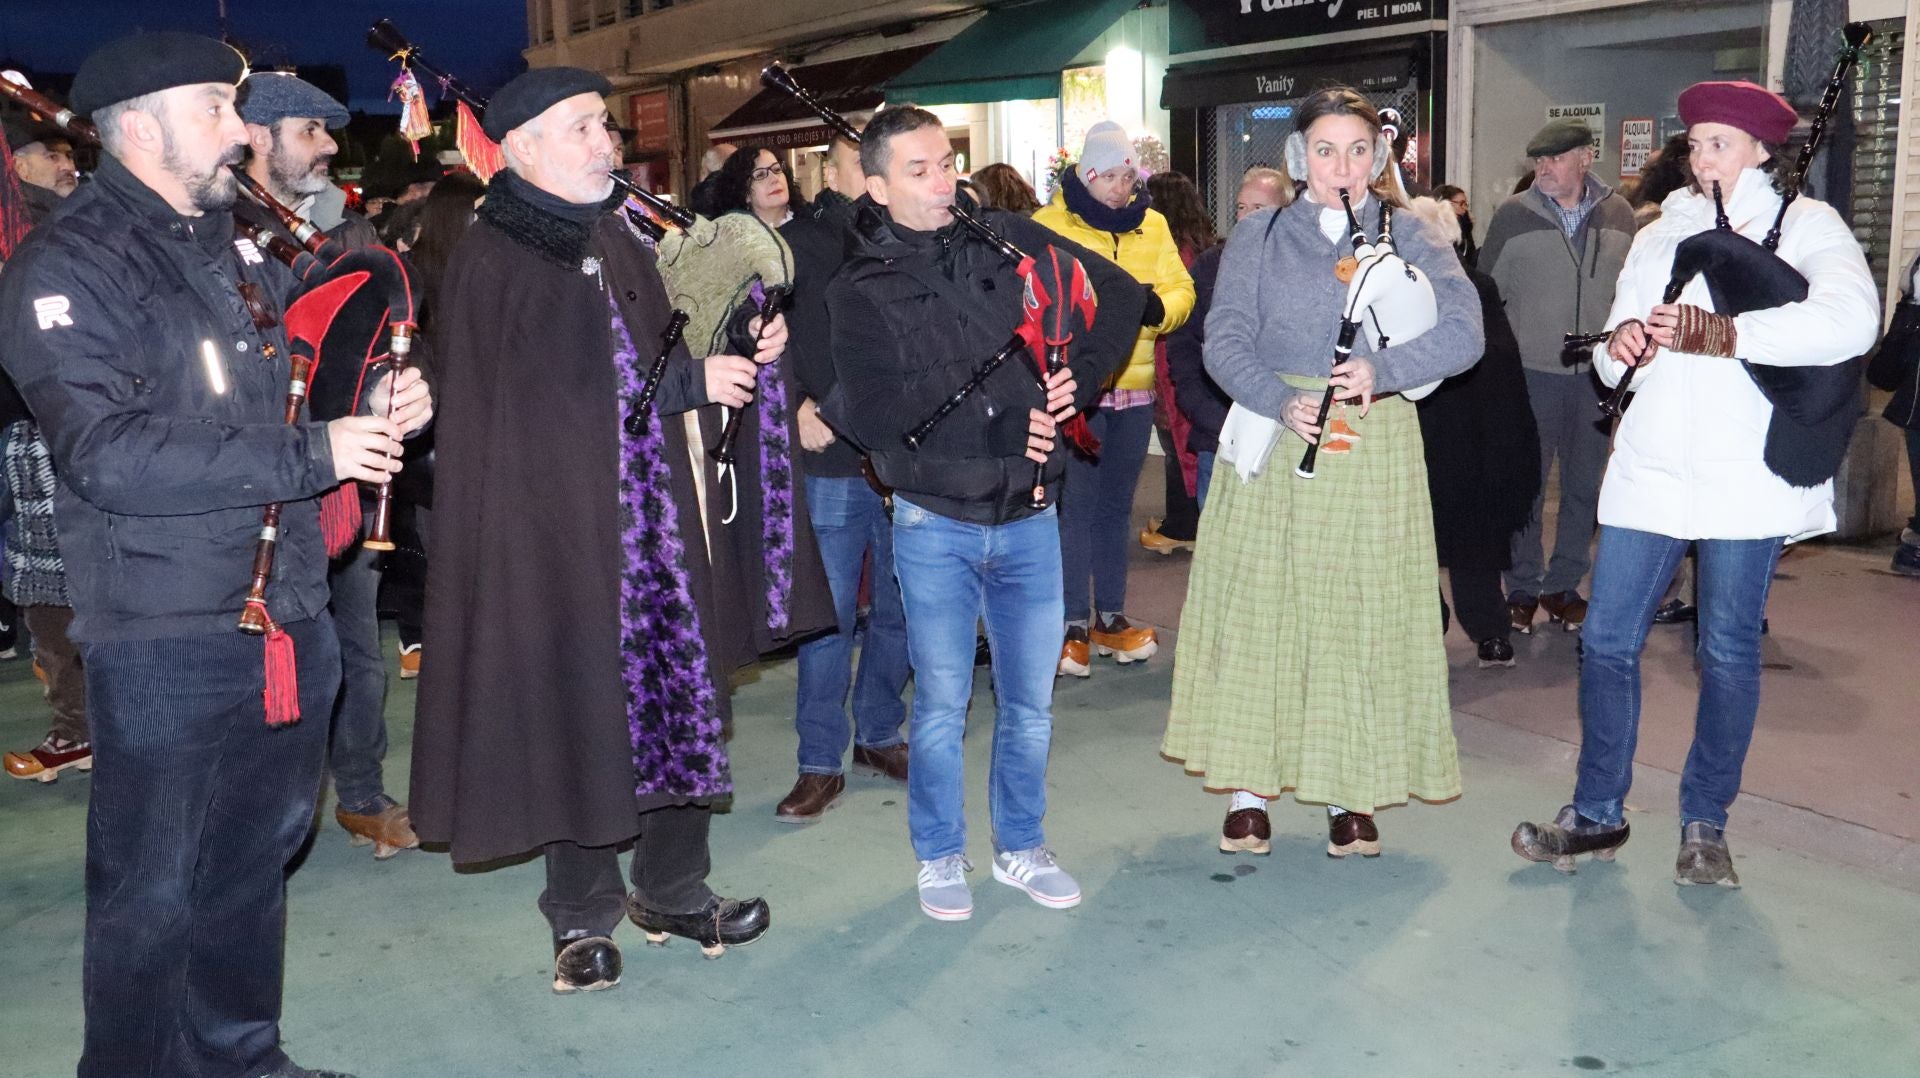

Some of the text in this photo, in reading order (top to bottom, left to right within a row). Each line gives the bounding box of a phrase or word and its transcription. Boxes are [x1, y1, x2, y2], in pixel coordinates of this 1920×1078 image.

[1357, 8, 1380, 20] PIEL
[1391, 2, 1422, 15] MODA
[1256, 75, 1294, 96] Vanity
[1549, 106, 1601, 118] SE ALQUILA
[1624, 122, 1651, 136] ALQUILA
[776, 134, 791, 145] ORO
[793, 130, 819, 144] RELOJES
